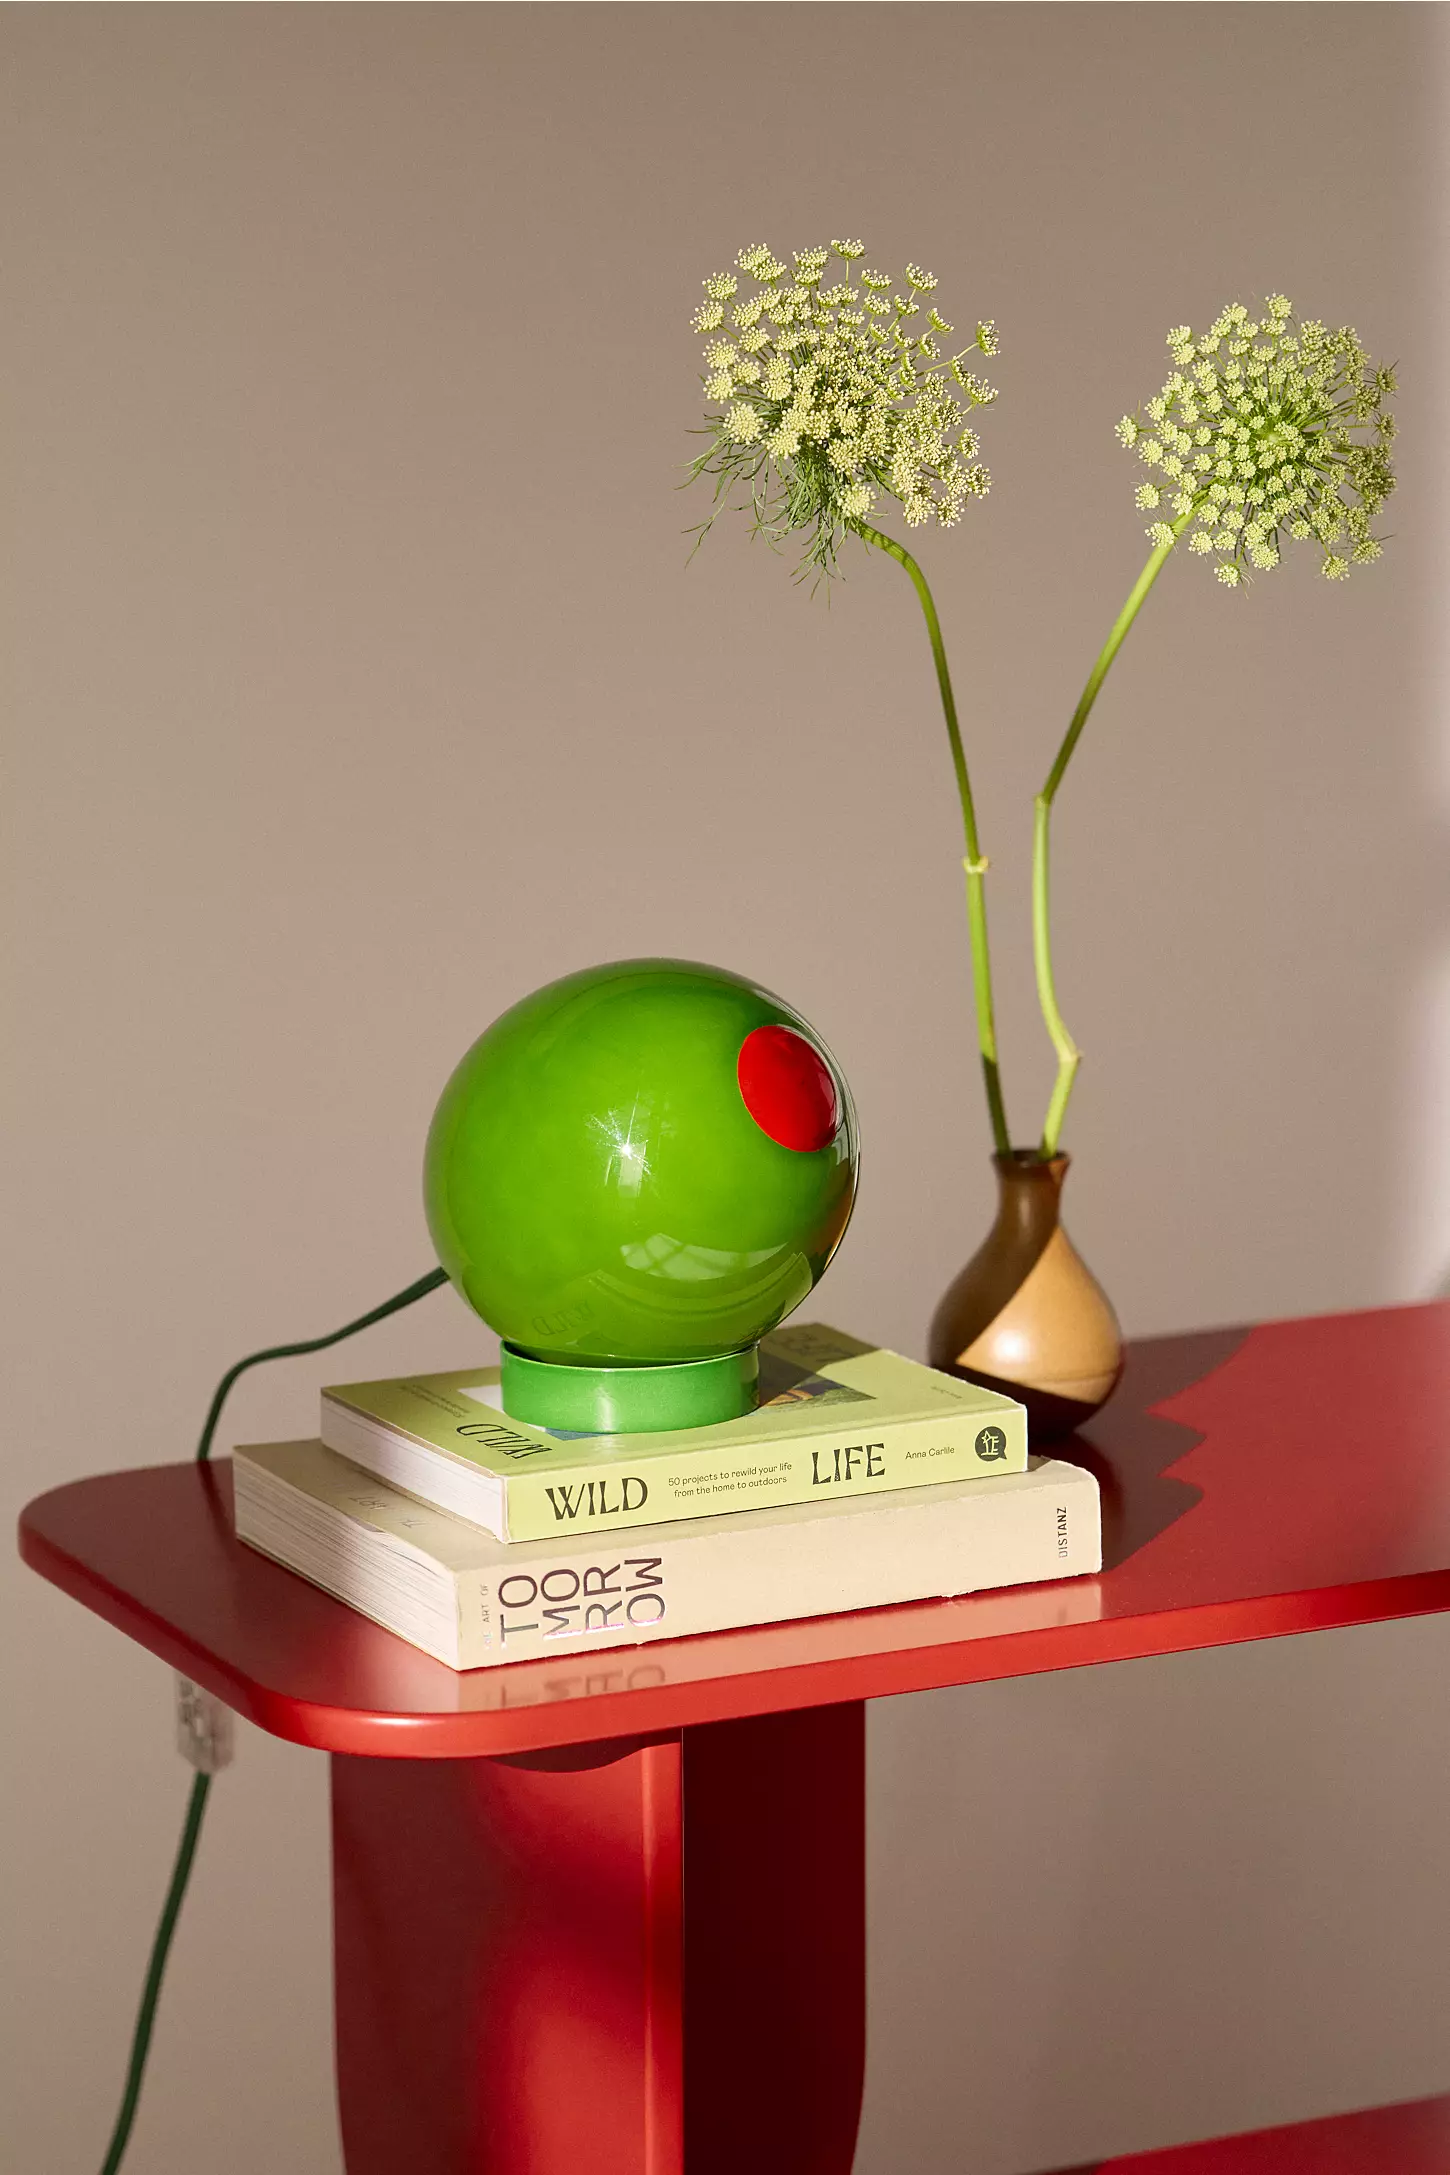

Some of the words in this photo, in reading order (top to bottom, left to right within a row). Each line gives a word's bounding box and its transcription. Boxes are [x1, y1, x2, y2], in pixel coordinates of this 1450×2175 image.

[456, 1423, 553, 1460] WILD
[905, 1451, 927, 1460] Anna
[928, 1446, 955, 1457] Carlile
[668, 1476, 681, 1487] 50
[682, 1474, 718, 1486] projects
[720, 1471, 730, 1480] to
[731, 1467, 757, 1478] rewild
[758, 1465, 778, 1475] your
[779, 1462, 792, 1471] life
[812, 1442, 886, 1485] LIFE
[544, 1477, 649, 1521] WILD
[674, 1489, 694, 1498] from
[696, 1487, 711, 1495] the
[712, 1484, 735, 1493] home
[737, 1481, 747, 1489] to
[748, 1476, 788, 1488] outdoors
[1056, 1506, 1068, 1558] DISTANZ
[482, 1603, 491, 1623] ART
[498, 1575, 539, 1648] TO
[540, 1569, 580, 1640] MO
[583, 1564, 624, 1634] RR
[624, 1557, 666, 1627] OW
